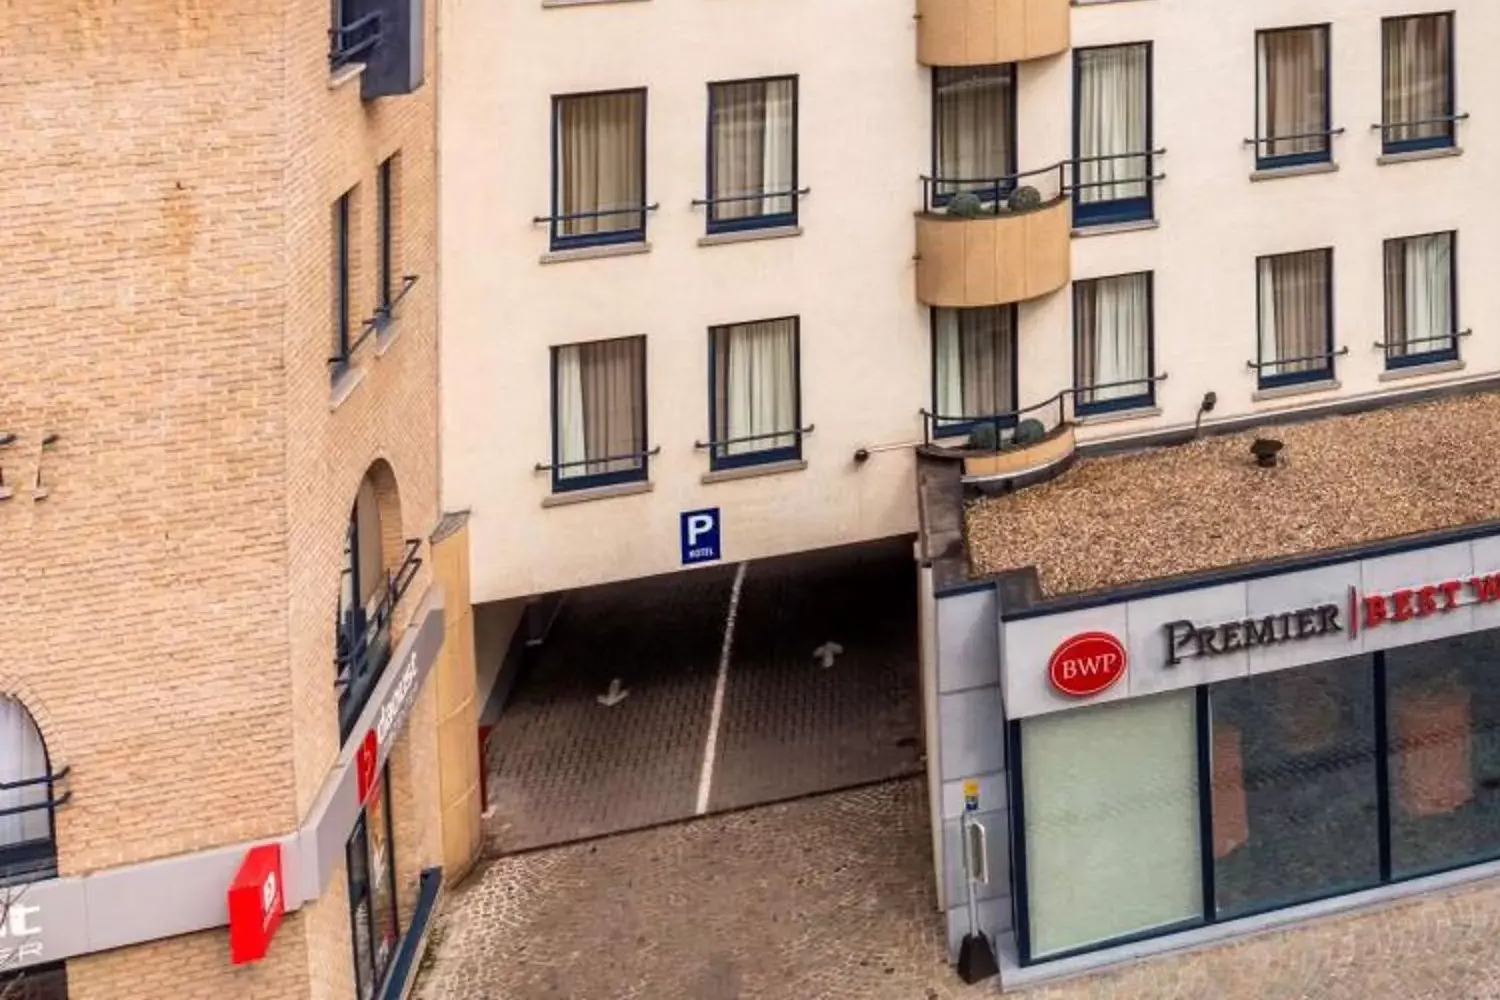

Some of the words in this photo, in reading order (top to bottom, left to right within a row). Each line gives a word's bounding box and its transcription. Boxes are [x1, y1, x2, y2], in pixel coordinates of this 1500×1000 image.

[688, 515, 713, 545] P
[1363, 579, 1462, 629] BEST
[1062, 653, 1117, 681] BWP
